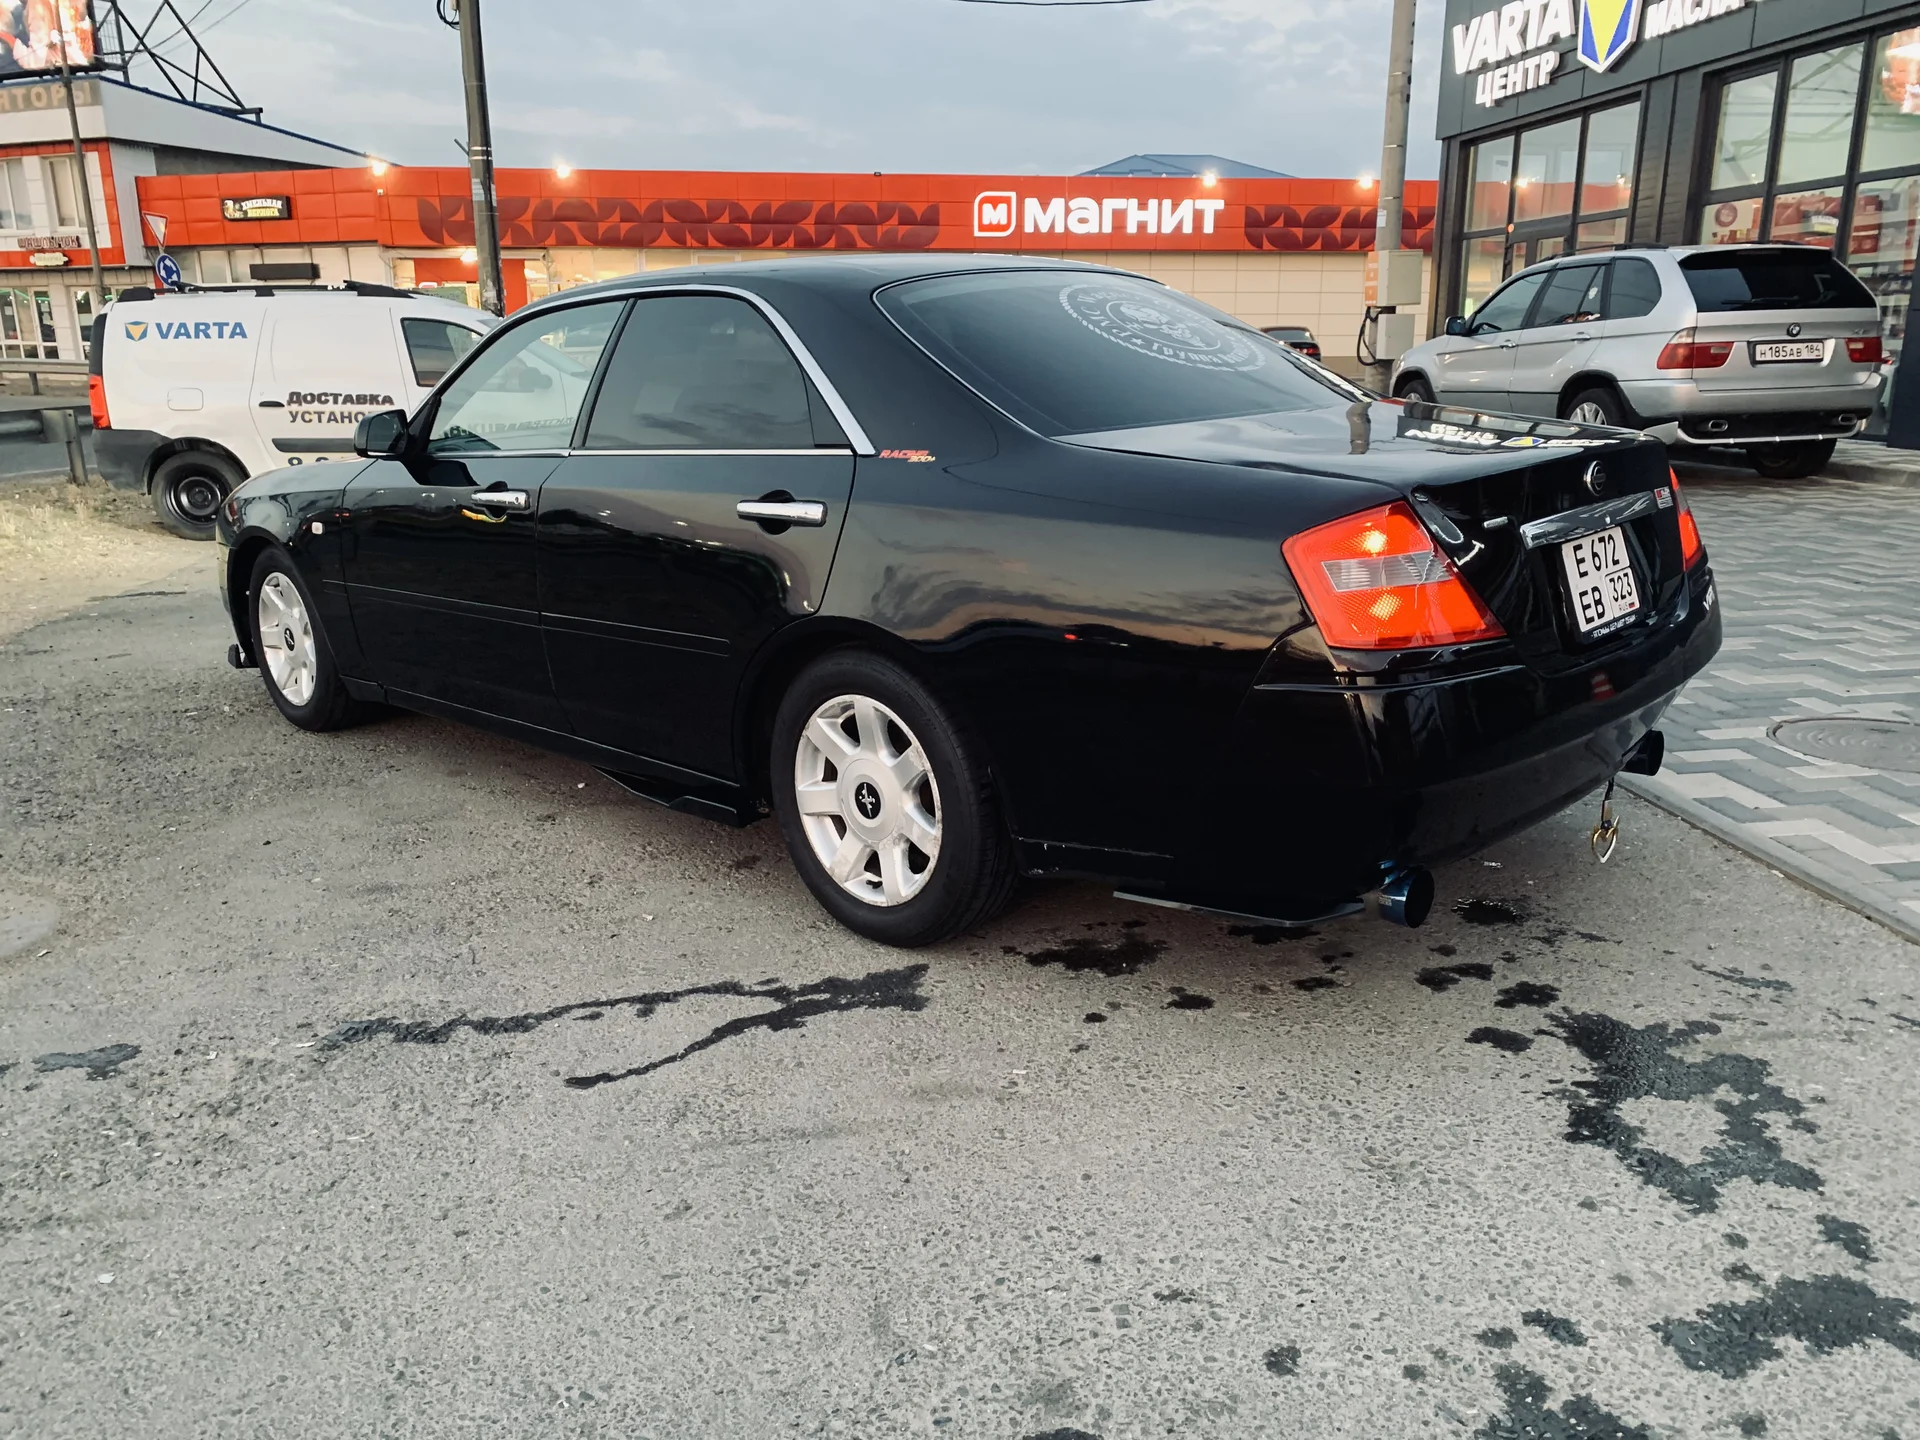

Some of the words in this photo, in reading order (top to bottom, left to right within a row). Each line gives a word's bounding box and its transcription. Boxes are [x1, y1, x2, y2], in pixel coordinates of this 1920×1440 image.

[1453, 0, 1574, 74] VARTA
[1476, 51, 1558, 107] ЦЕНТР
[155, 322, 248, 339] VARTA
[287, 391, 395, 406] ДОСТАВКА
[288, 411, 370, 424] УСТАНО
[1609, 572, 1632, 602] 323
